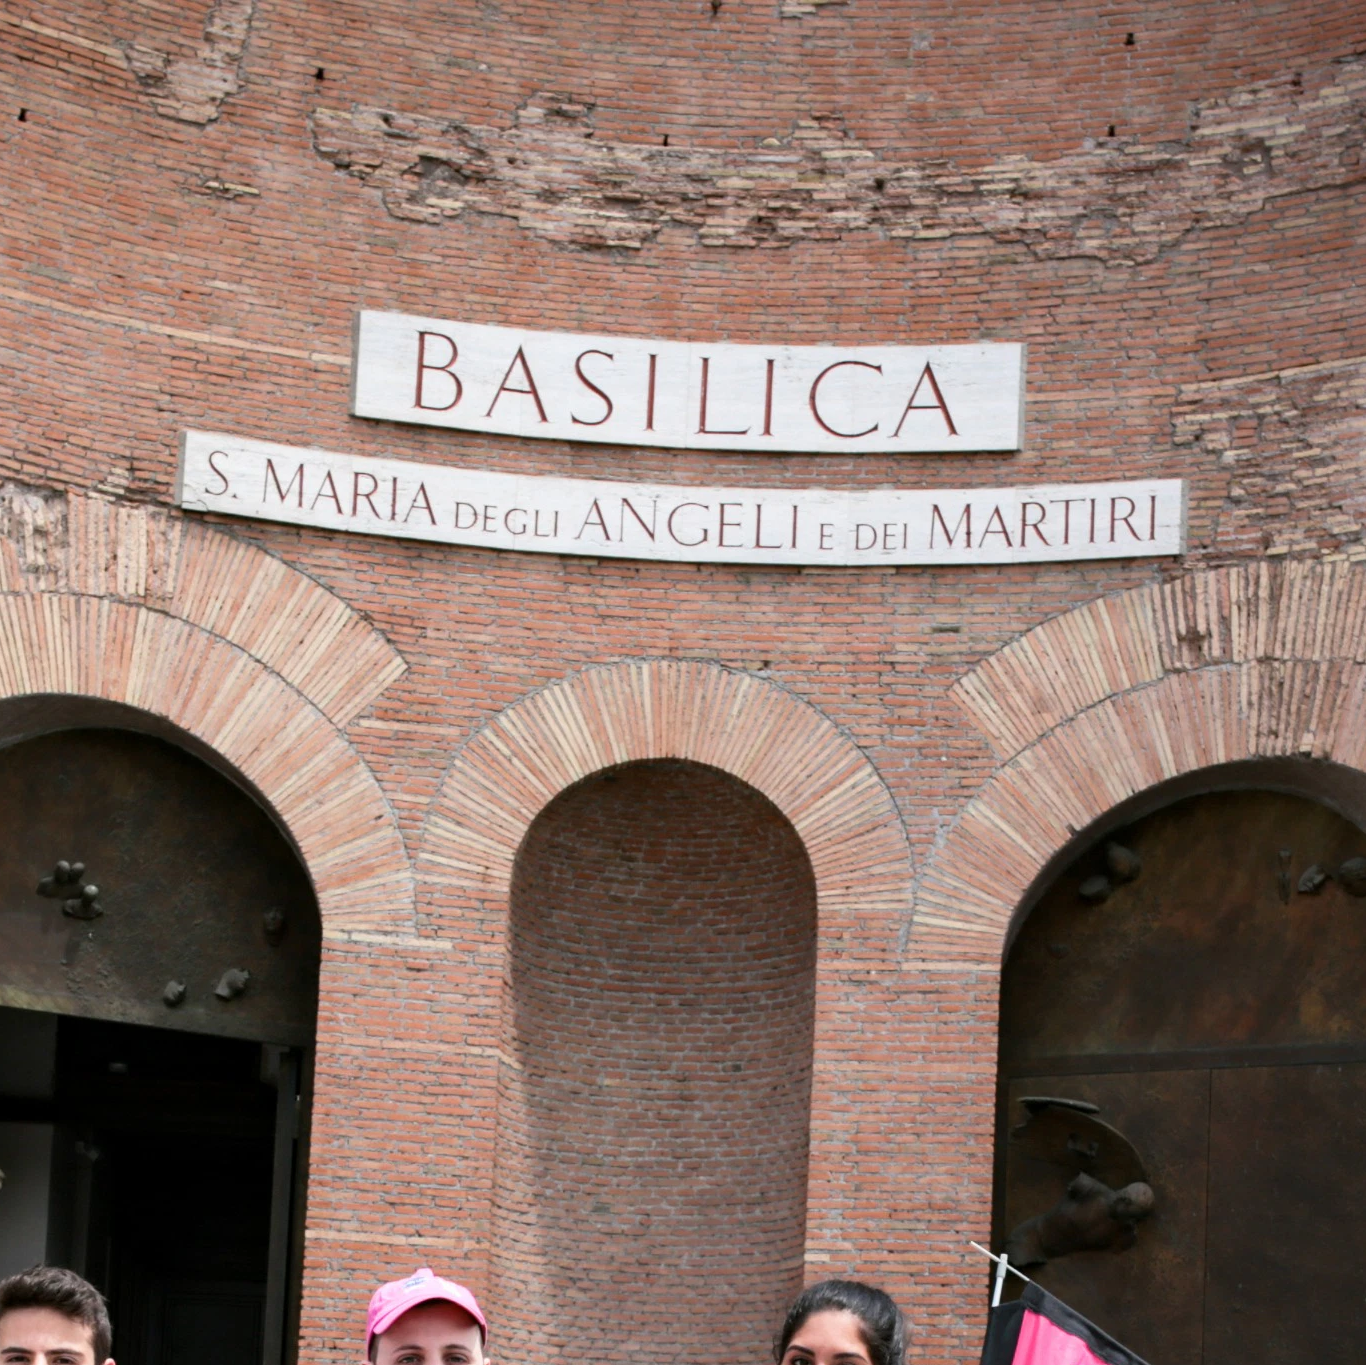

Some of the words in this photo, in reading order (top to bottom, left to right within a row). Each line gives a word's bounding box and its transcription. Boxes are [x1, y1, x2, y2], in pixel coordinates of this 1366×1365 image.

[411, 330, 960, 438] BASILICA
[204, 451, 238, 499] S.
[263, 458, 437, 526] MARIA
[453, 501, 559, 538] DEGLI
[573, 497, 799, 549] ANGELI
[819, 523, 835, 550] E
[854, 523, 908, 550] DEI
[929, 495, 1158, 549] MARTIRI
